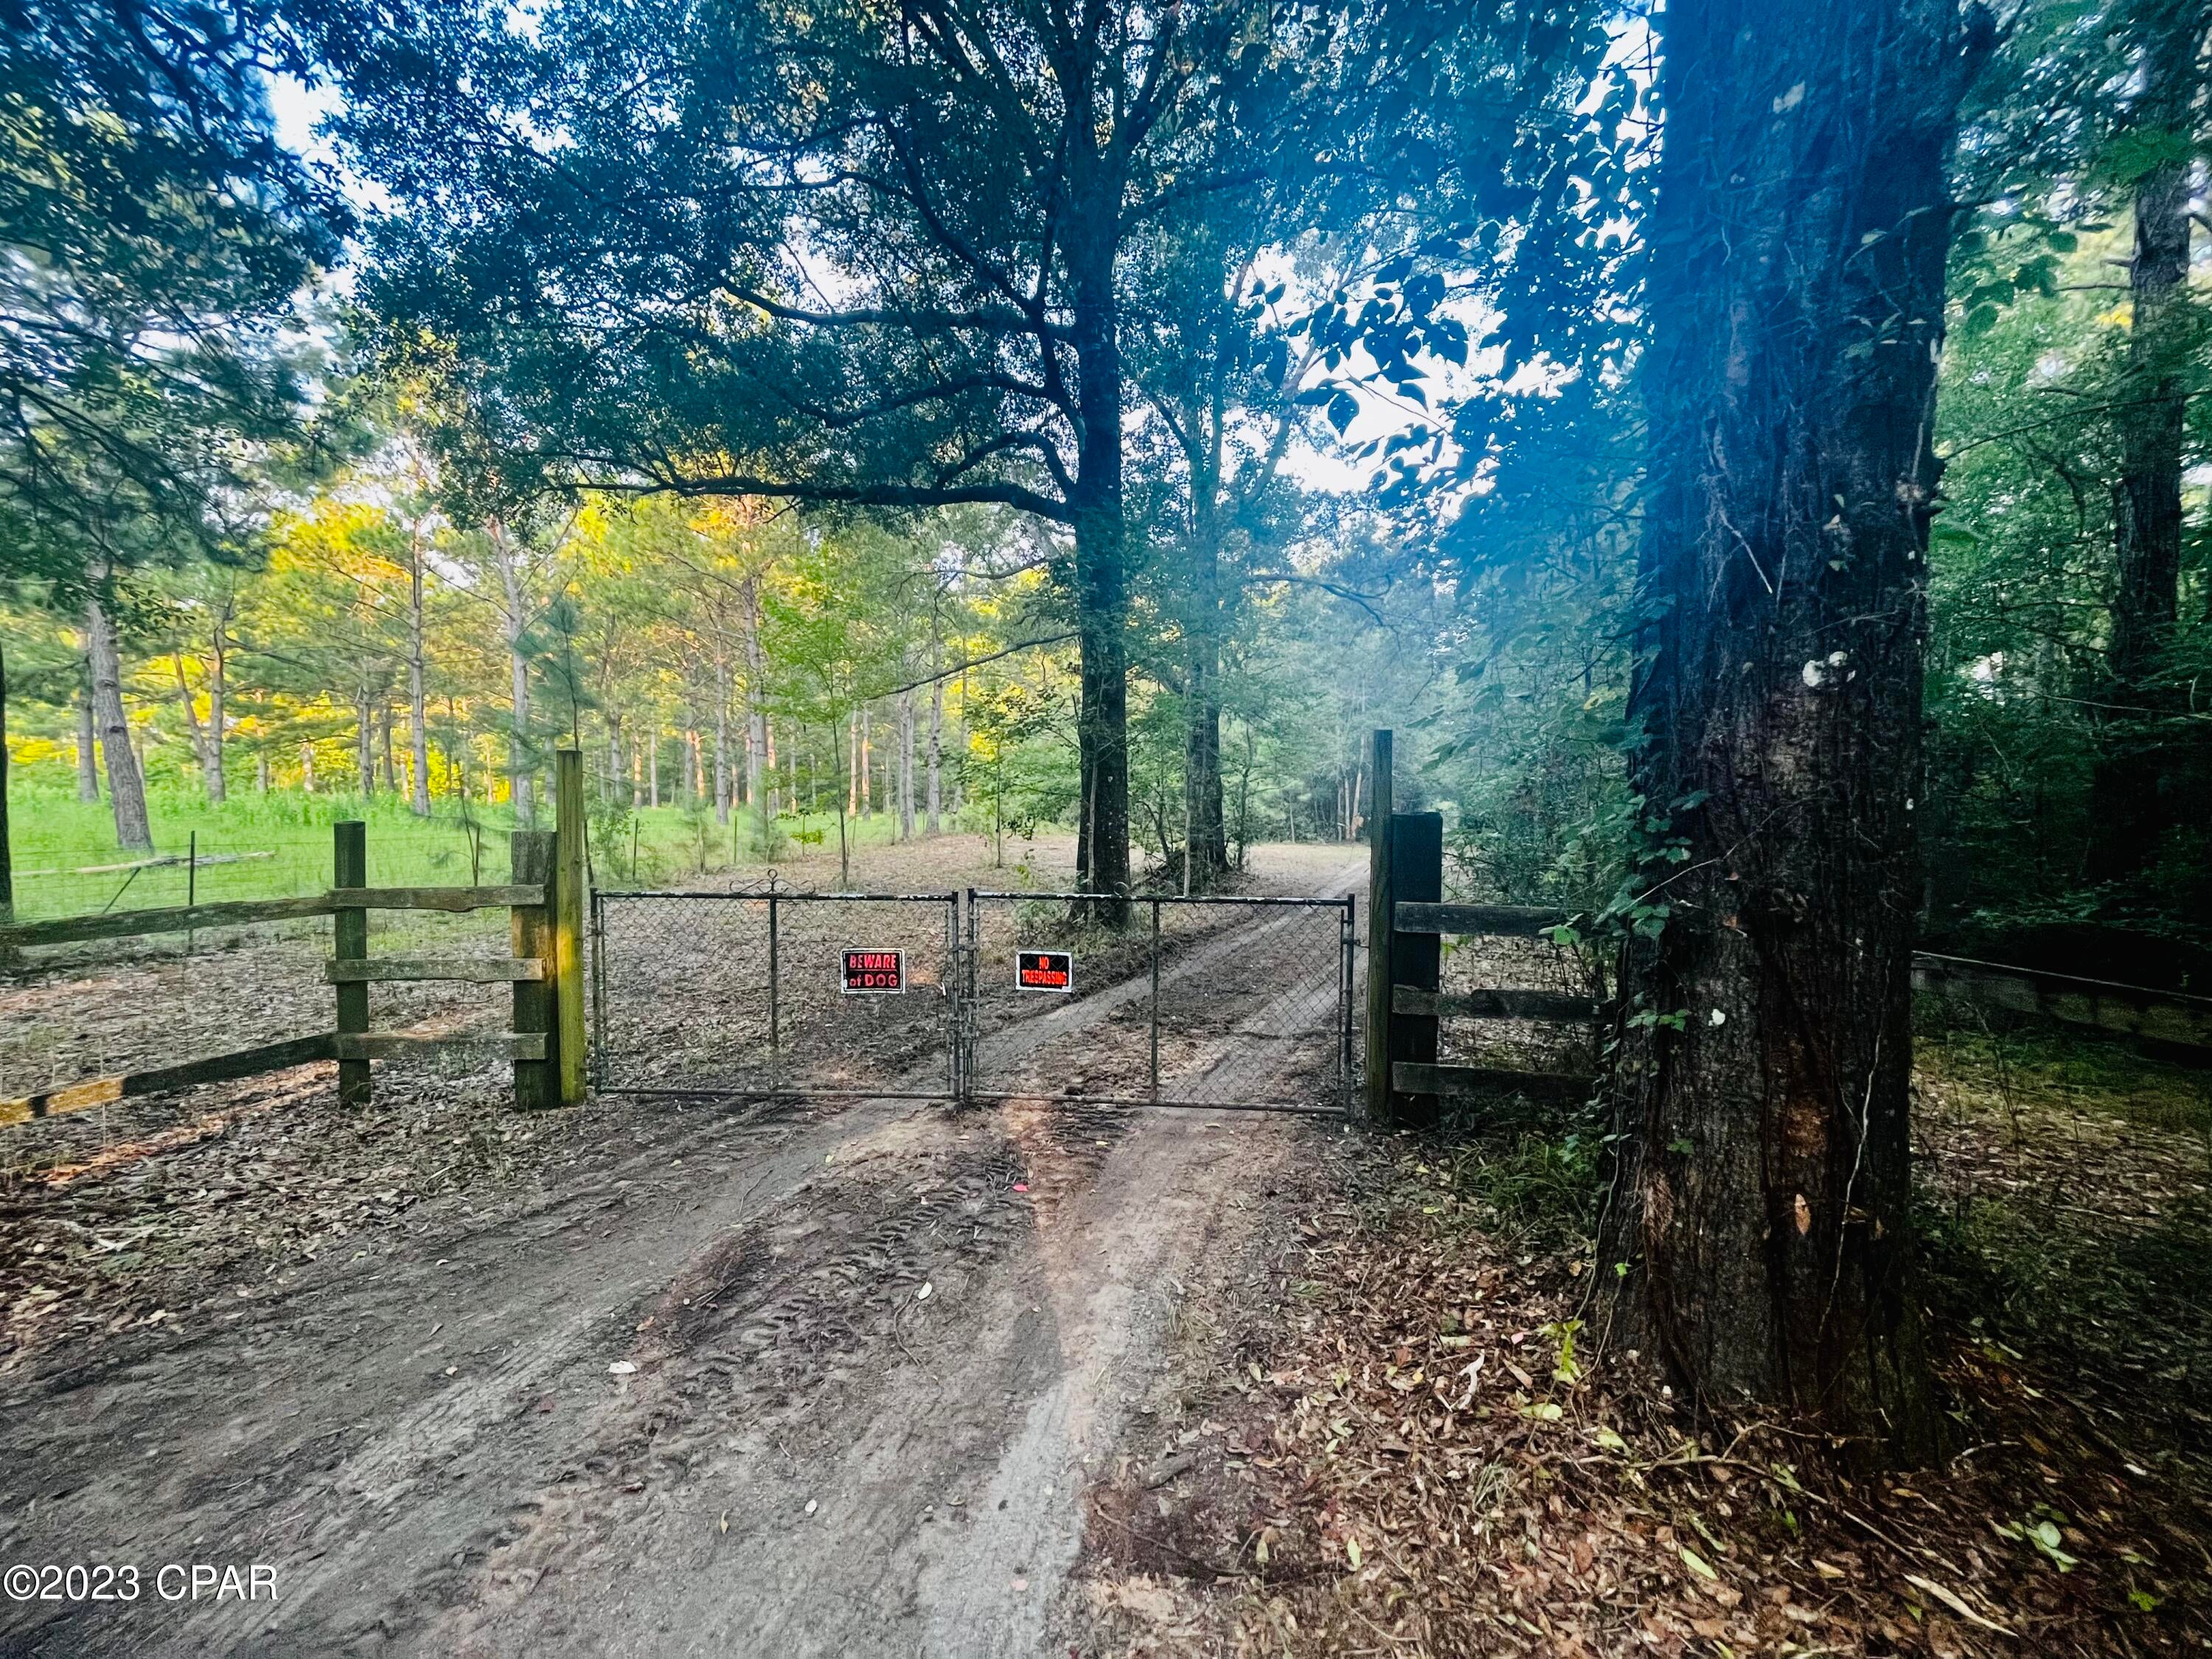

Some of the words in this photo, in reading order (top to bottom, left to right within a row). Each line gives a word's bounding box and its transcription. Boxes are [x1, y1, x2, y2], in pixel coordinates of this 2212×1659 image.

[849, 954, 897, 968] BEWARE
[1039, 956, 1049, 970] NO
[849, 975, 861, 987] of
[864, 974, 897, 987] DOG
[1022, 970, 1067, 985] TRESPASSING
